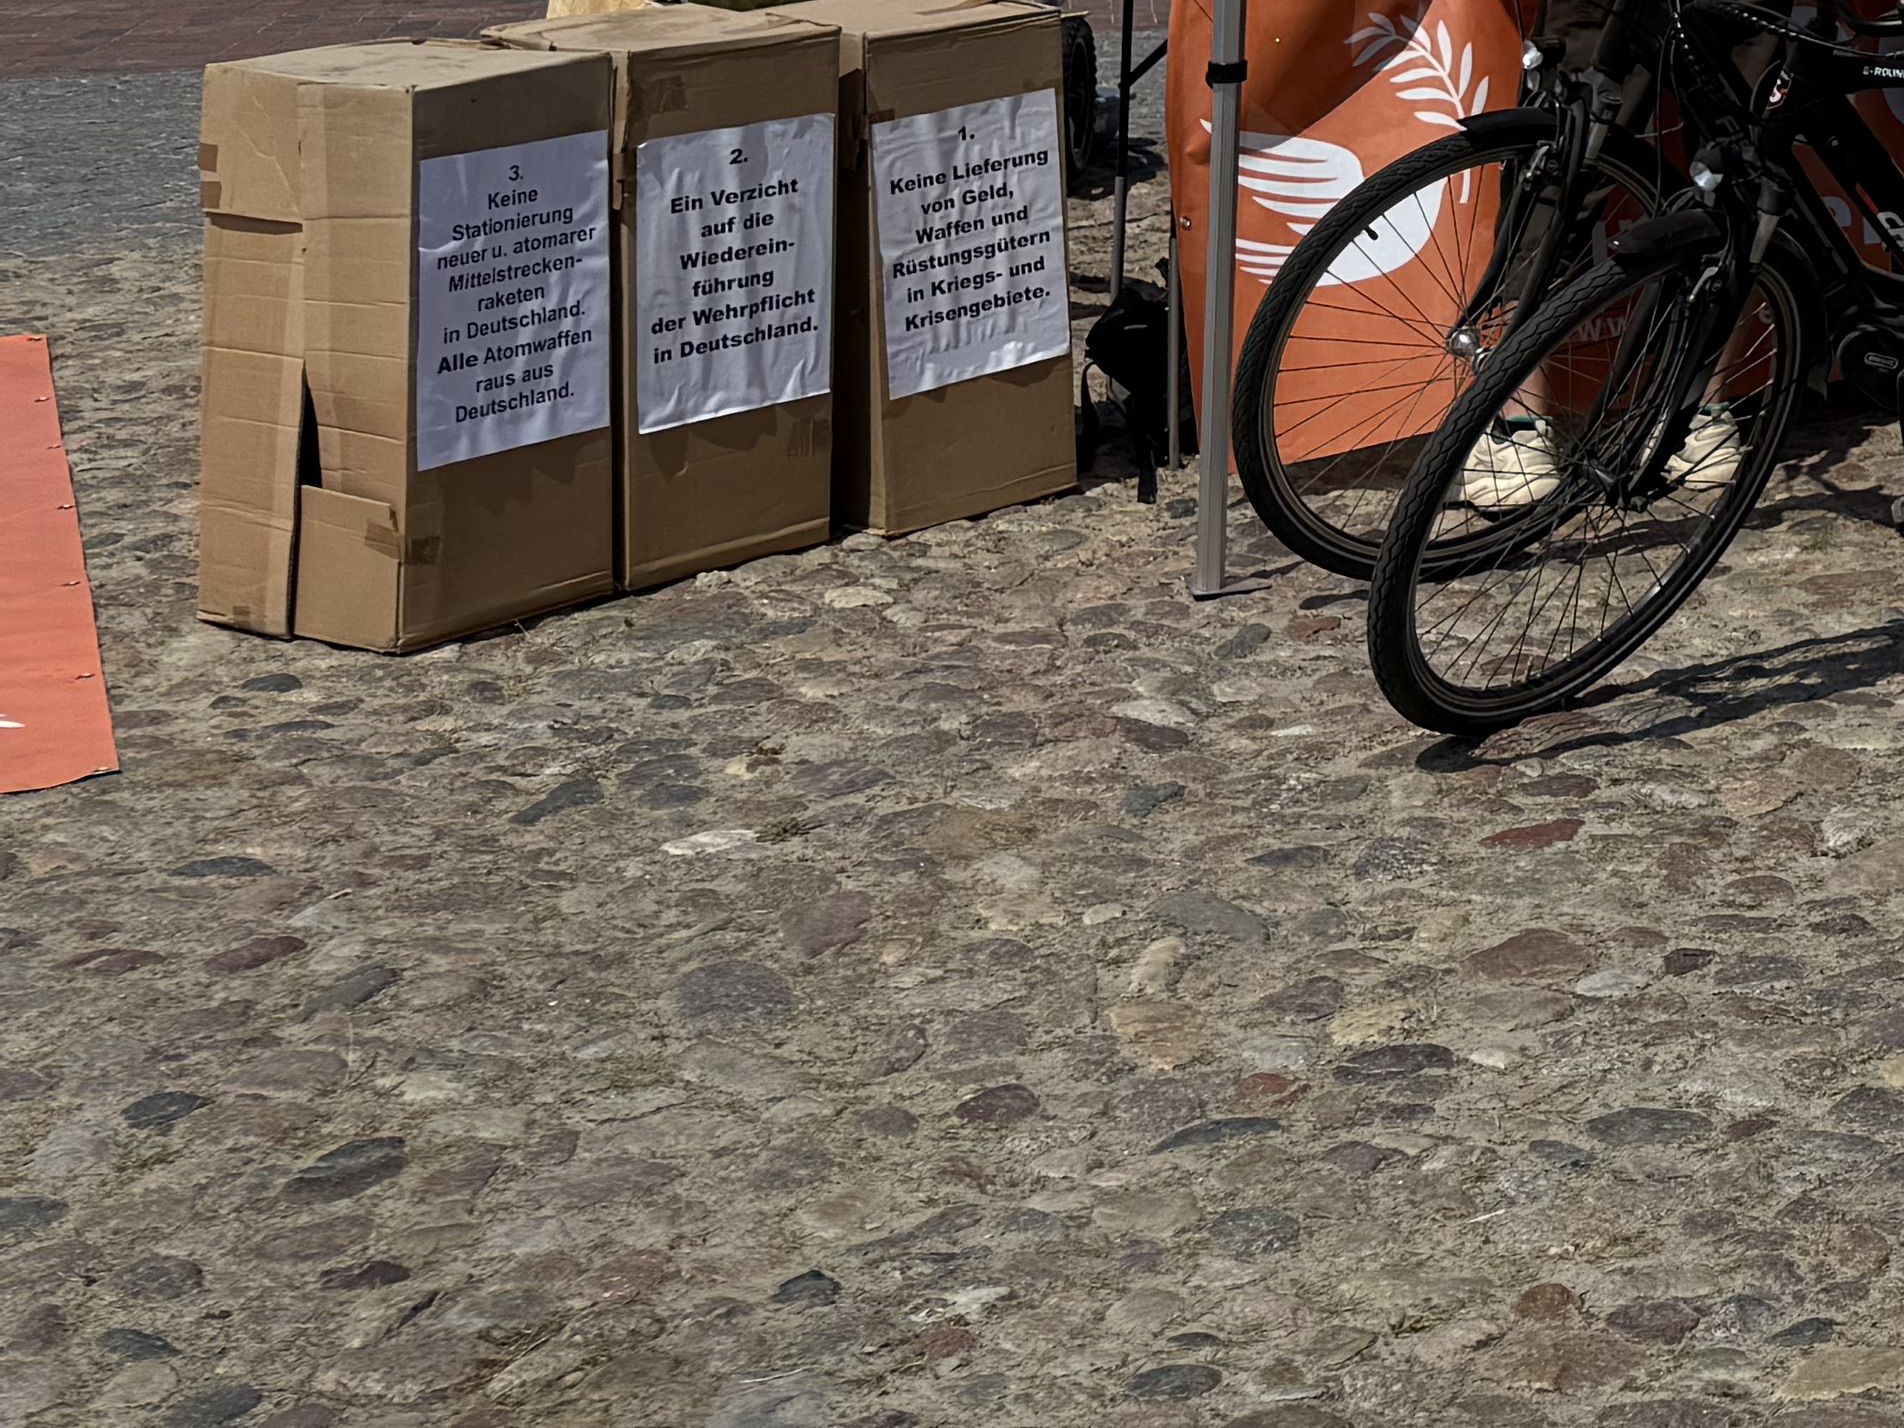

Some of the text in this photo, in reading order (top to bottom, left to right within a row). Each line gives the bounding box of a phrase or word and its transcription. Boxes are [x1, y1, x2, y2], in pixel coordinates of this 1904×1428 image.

[958, 126, 975, 141] 1.
[508, 165, 524, 181] 3.
[729, 149, 748, 165] 2.
[890, 149, 1048, 195] Keine Lieferung
[488, 187, 538, 210] Keine
[670, 178, 798, 214] Ein Verzicht
[921, 182, 1014, 215] von Geld,
[452, 207, 573, 241] Stationierung
[700, 211, 774, 238] auf die
[915, 205, 1028, 245] Waffen und
[437, 225, 596, 270] neuer u. atomarer
[680, 237, 795, 270] Wiederein-
[893, 230, 1051, 279] Rüstungsgütern
[449, 254, 583, 293] Mittelstrecken-
[692, 270, 774, 297] führung
[907, 255, 1045, 303] in Kriegs- und
[477, 286, 545, 312] raketen
[651, 288, 815, 335] der Wehrpflicht
[905, 285, 1051, 332] Krisengebiete.
[444, 300, 586, 345] in Deutschland.
[654, 316, 818, 364] in Deutschland.
[437, 328, 593, 374] Alle Atomwaffen
[476, 364, 554, 393] raus aus
[456, 382, 574, 423] Deutschland.
